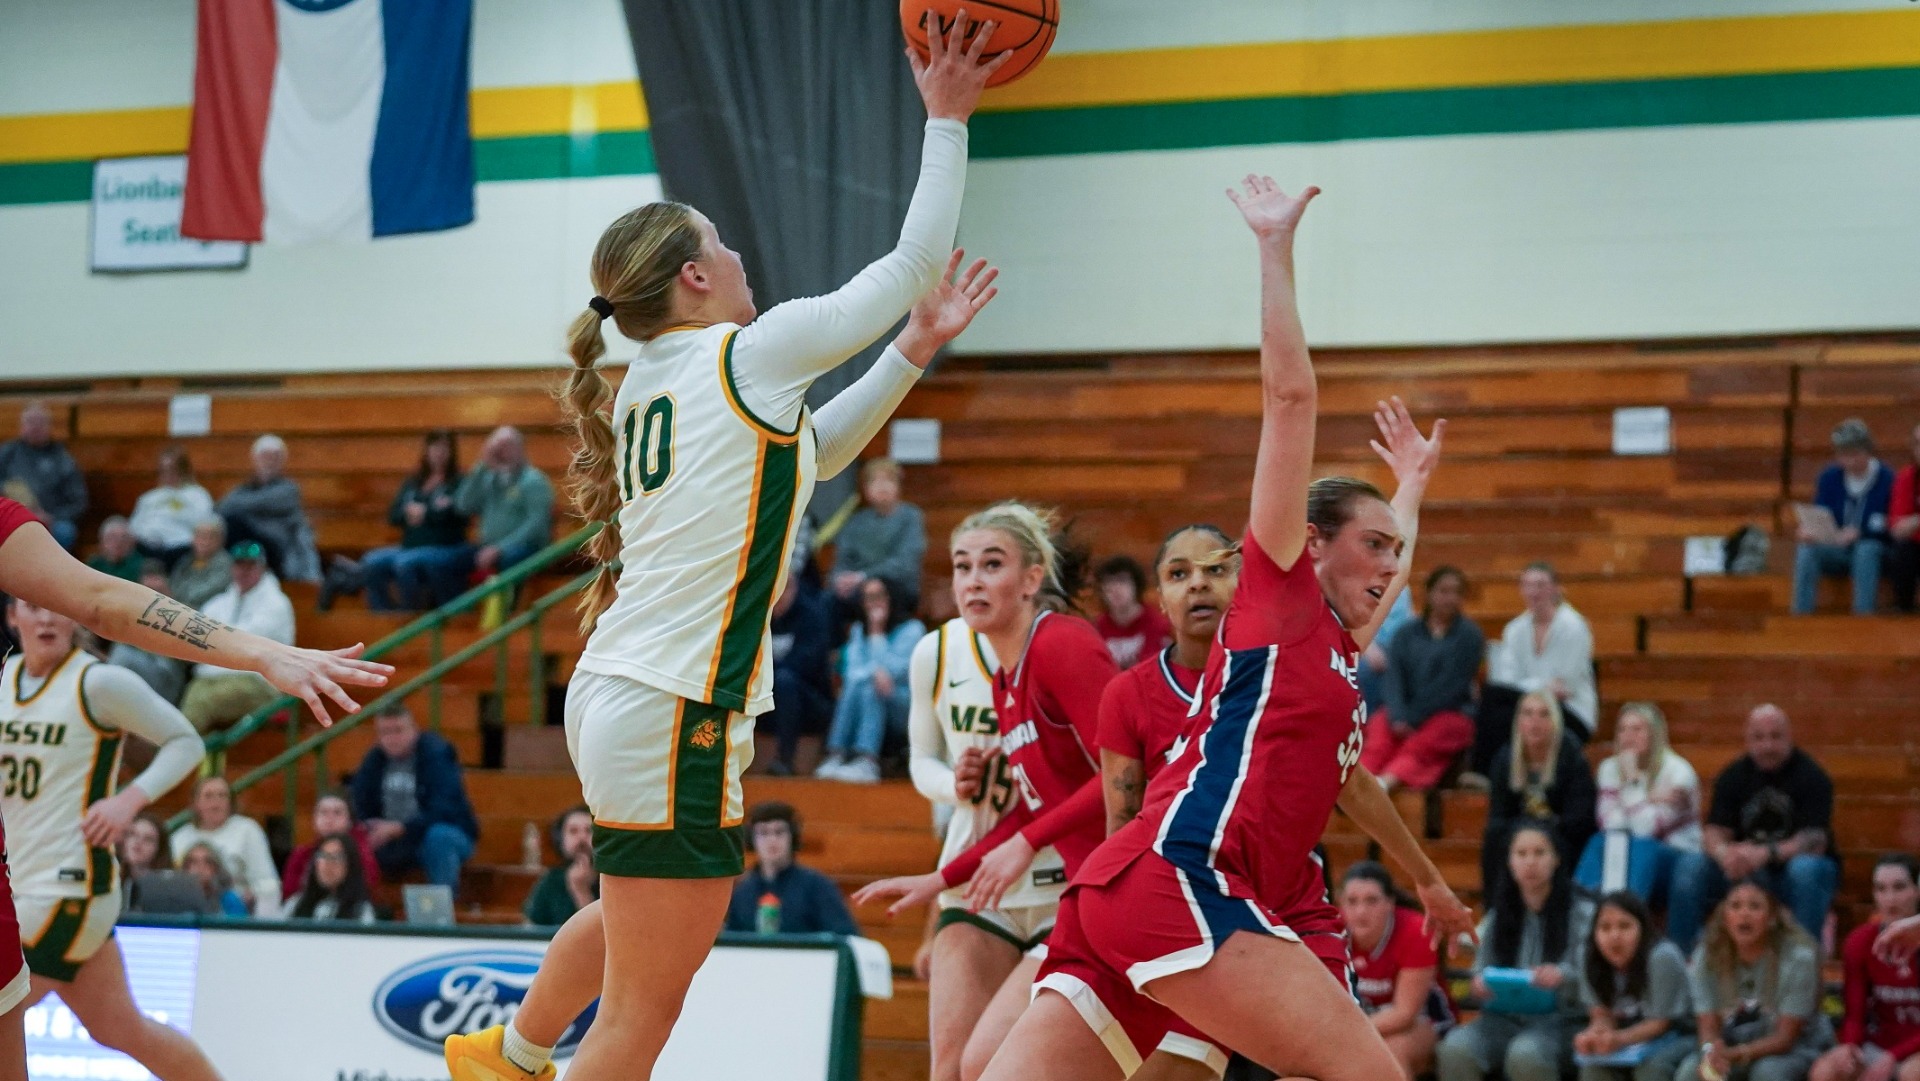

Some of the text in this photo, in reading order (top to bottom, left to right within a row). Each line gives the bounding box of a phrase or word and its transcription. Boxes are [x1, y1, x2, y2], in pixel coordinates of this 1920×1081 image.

[101, 174, 184, 202] Lionba
[623, 392, 677, 506] 10
[1329, 647, 1360, 690] NE
[0, 720, 67, 745] SSU
[951, 704, 1000, 734] MS
[0, 754, 41, 799] 30
[420, 965, 576, 1042] Fo
